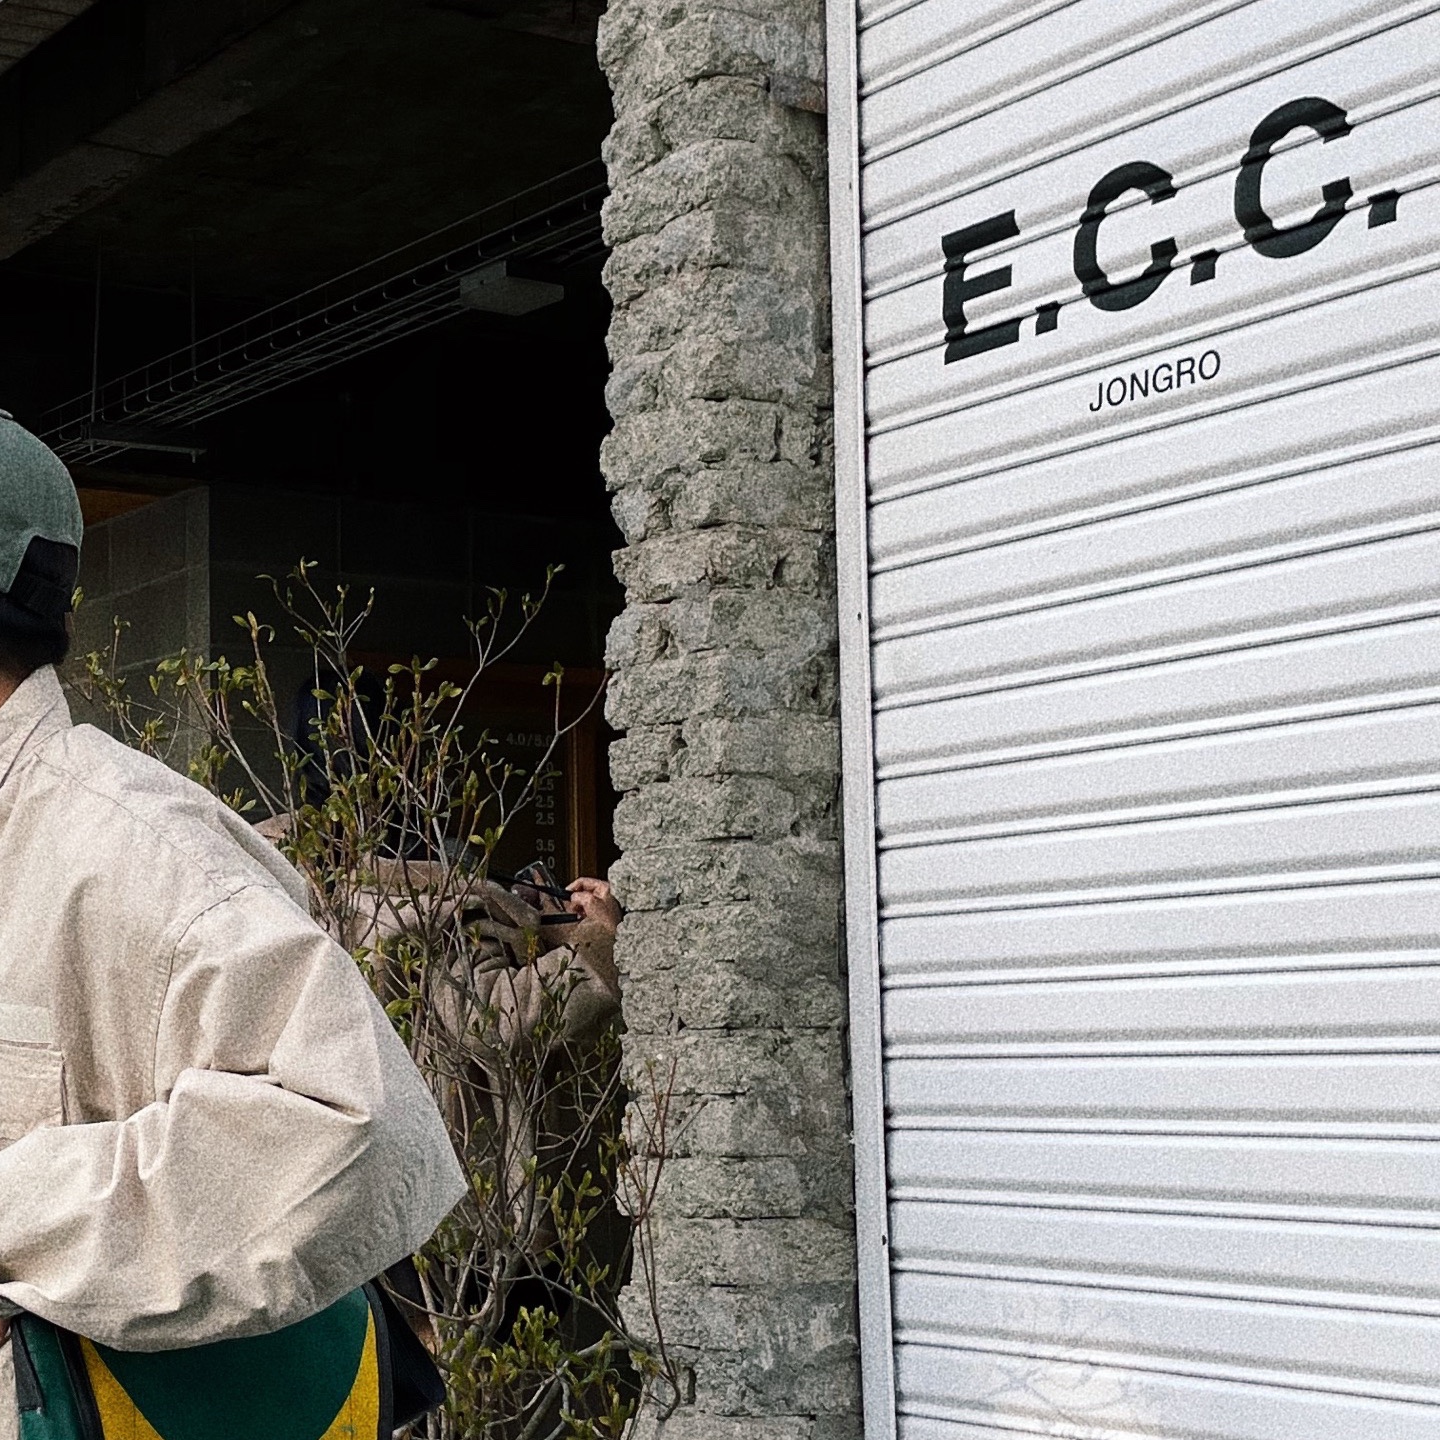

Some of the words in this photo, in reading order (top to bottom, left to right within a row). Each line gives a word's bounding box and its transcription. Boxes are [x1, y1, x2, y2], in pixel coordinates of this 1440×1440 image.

[941, 96, 1402, 365] E.C.C.
[1089, 350, 1221, 411] JONGRO
[536, 812, 554, 825] 2.5
[536, 839, 555, 852] 3.5
